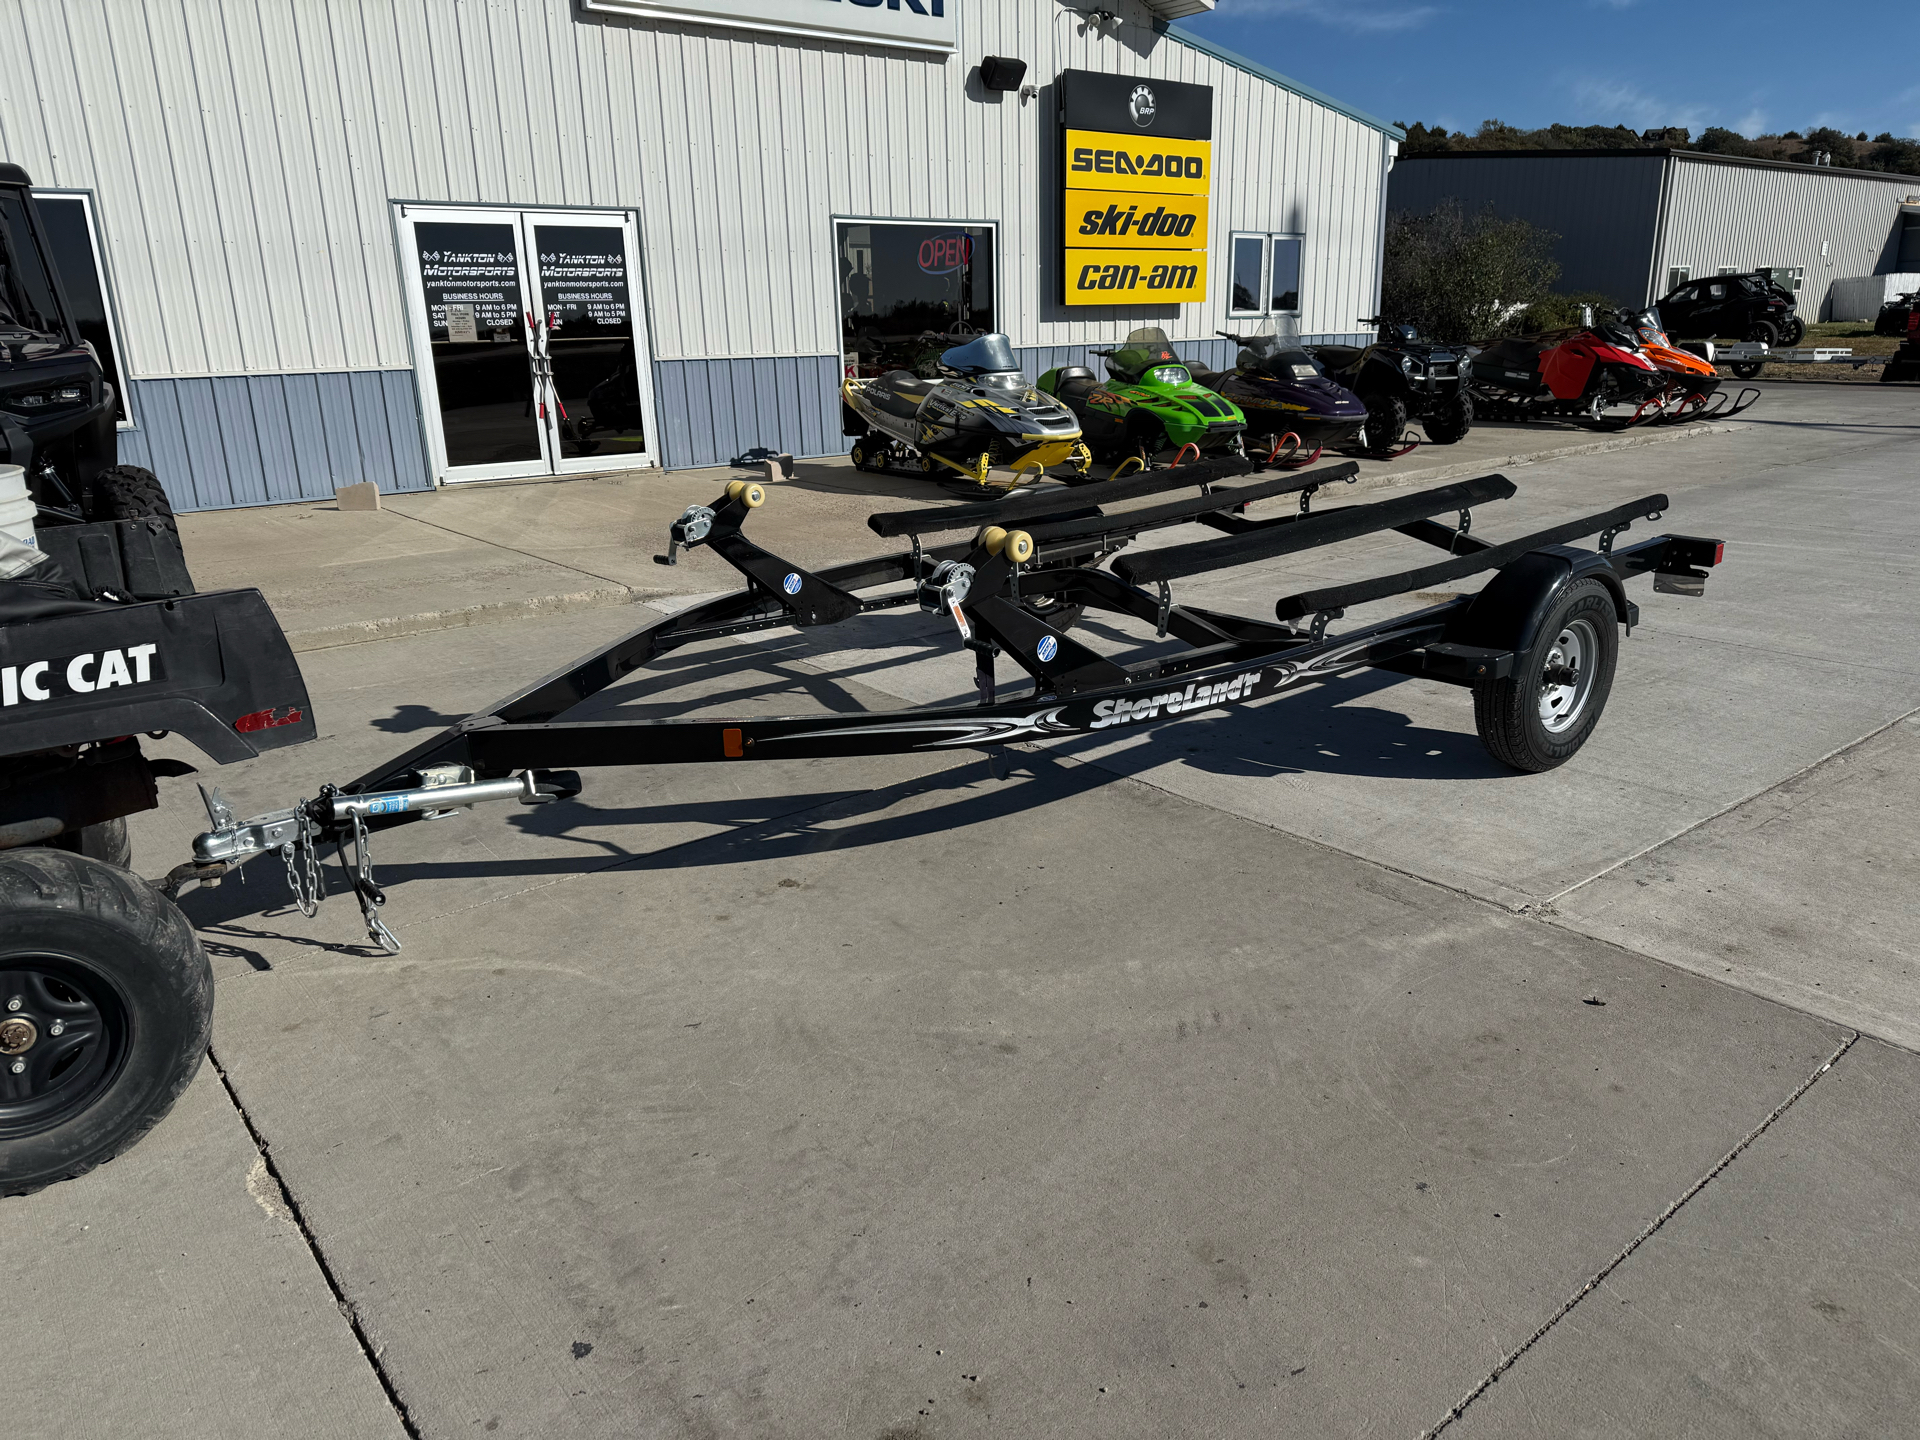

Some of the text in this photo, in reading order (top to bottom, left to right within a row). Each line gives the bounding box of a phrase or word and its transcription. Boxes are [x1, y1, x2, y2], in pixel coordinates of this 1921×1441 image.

[1139, 106, 1155, 115] BRP
[1078, 204, 1197, 238] ski-doo
[443, 251, 496, 263] YANKTON
[558, 253, 606, 264] YANKTON
[918, 238, 970, 268] OPEN
[423, 264, 515, 276] MOTORSPORTS
[541, 266, 624, 277] MOTORSPORTS
[1076, 264, 1198, 291] can-am
[426, 280, 516, 289] yanktonmotorsports.com
[543, 281, 624, 289] yanktonmotorsports.com
[865, 386, 891, 401] POLARIS
[66, 643, 157, 693] CAT
